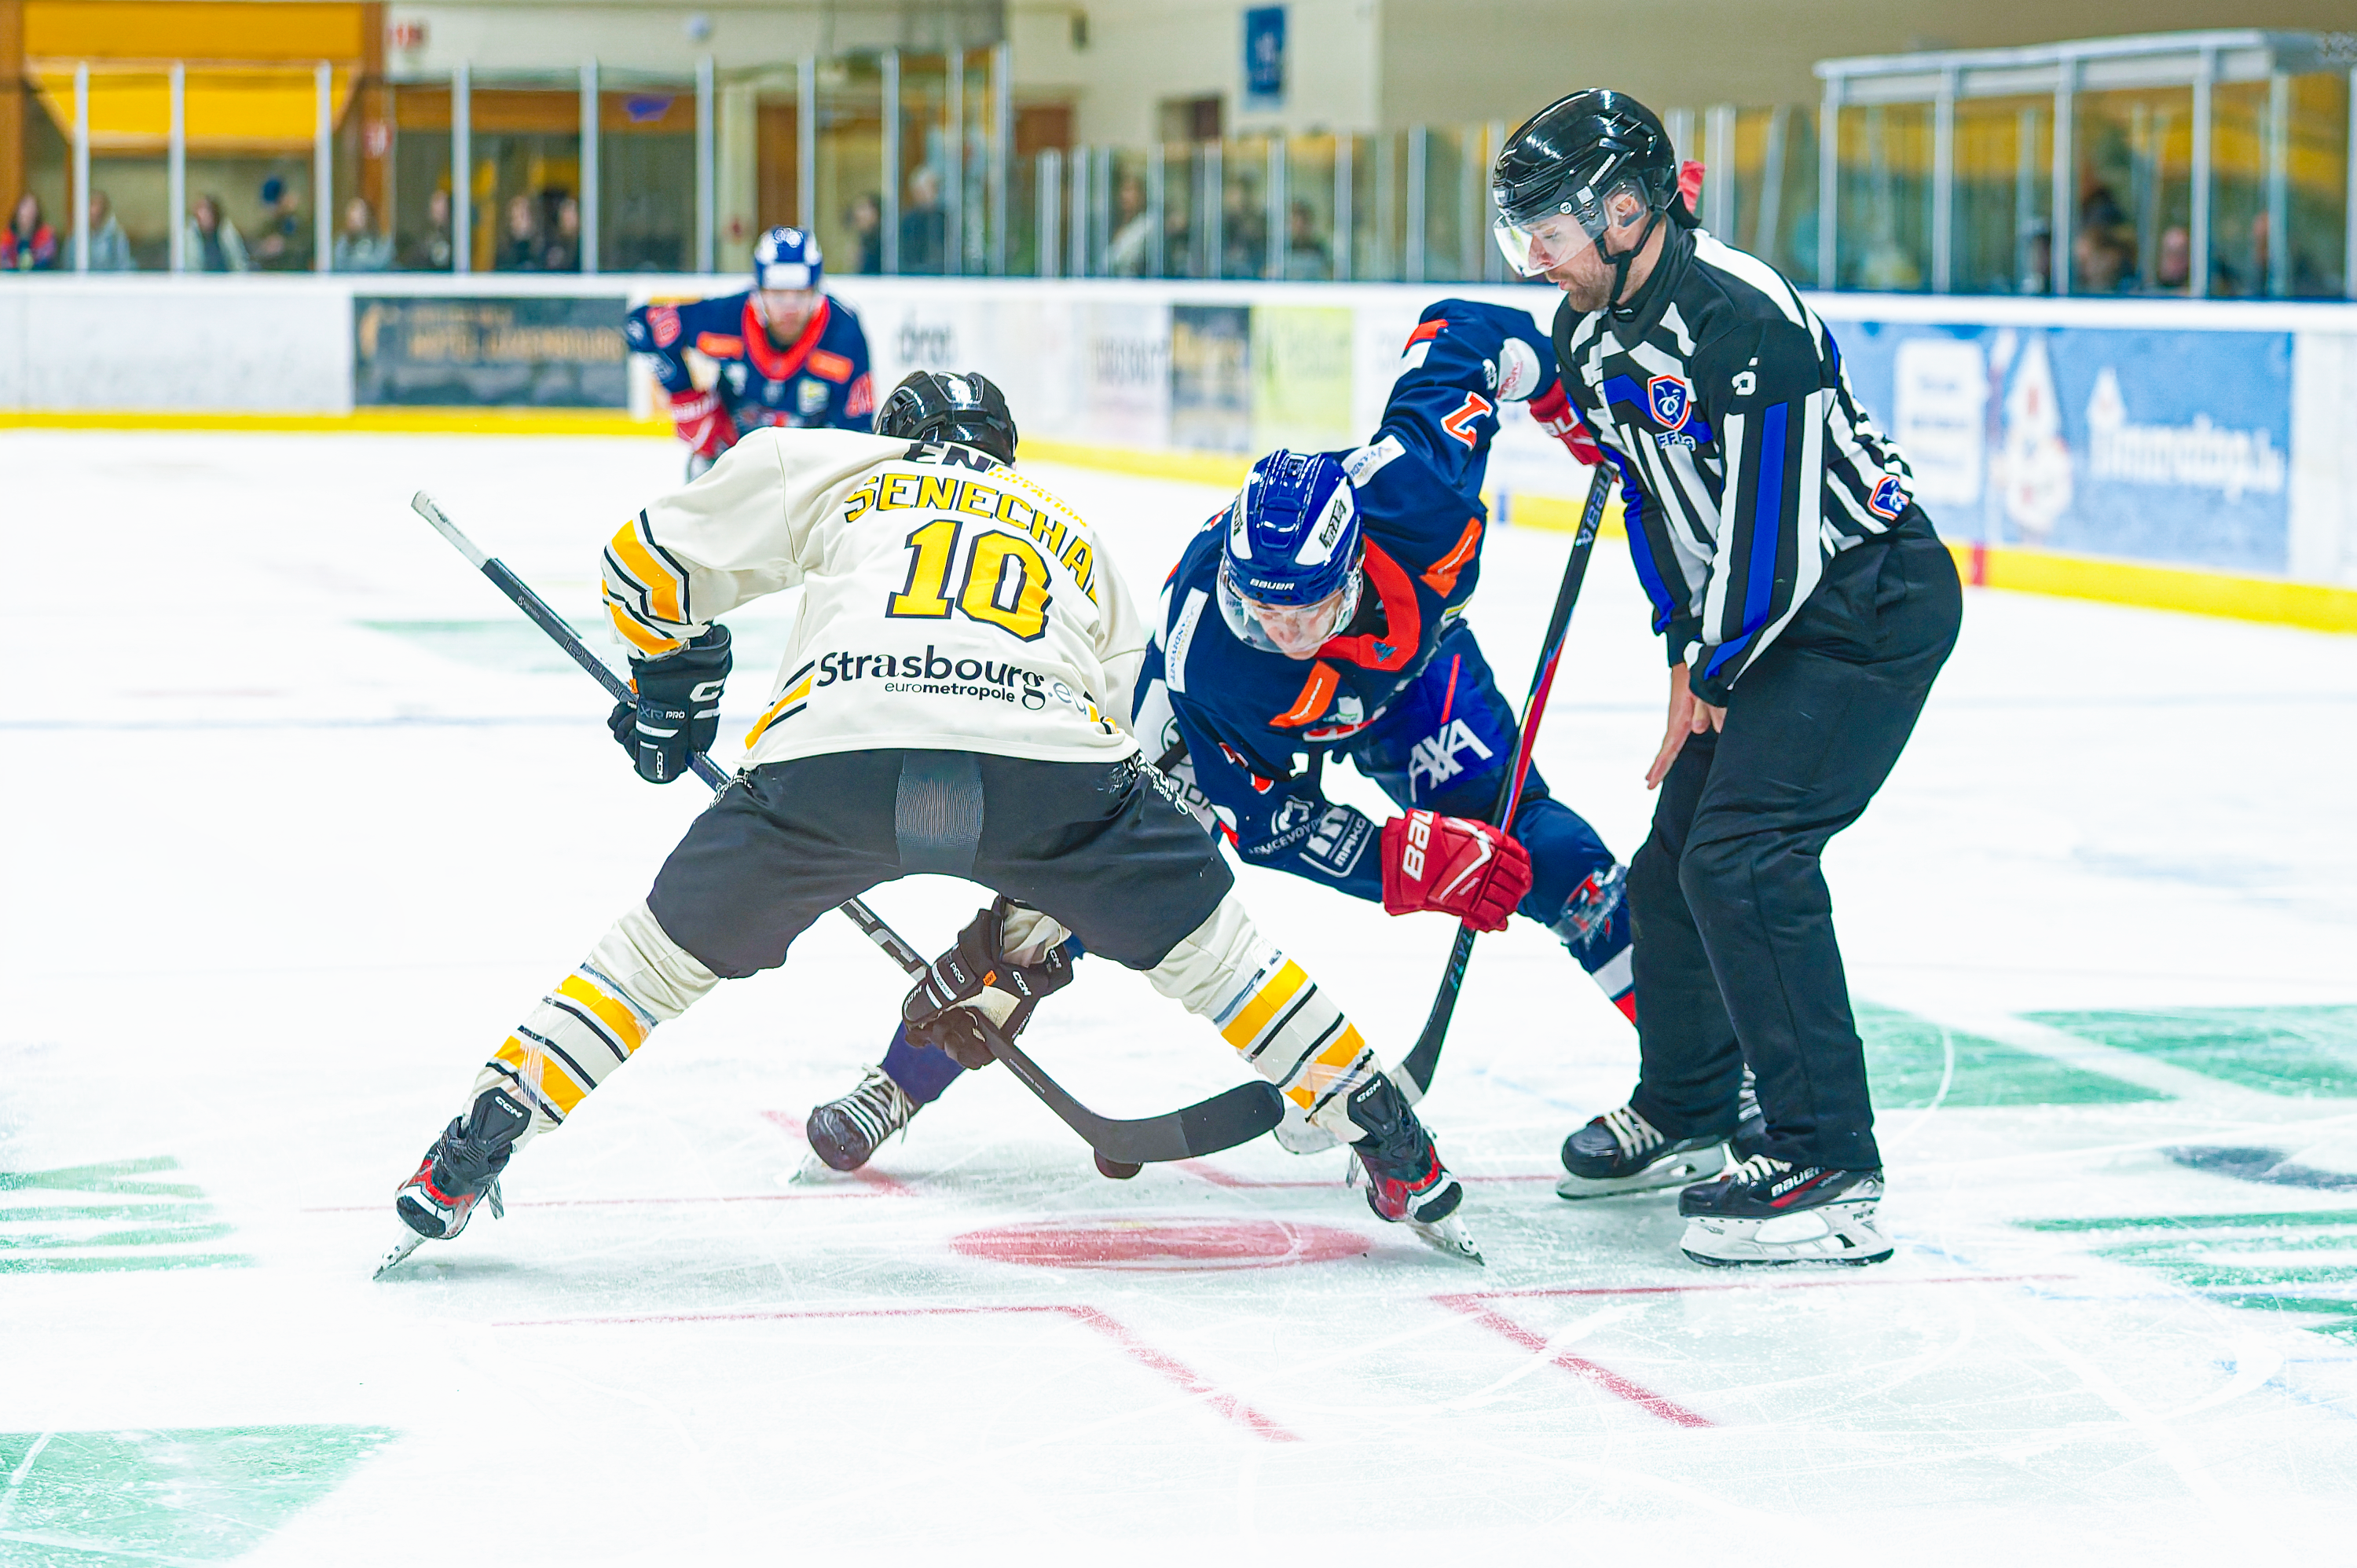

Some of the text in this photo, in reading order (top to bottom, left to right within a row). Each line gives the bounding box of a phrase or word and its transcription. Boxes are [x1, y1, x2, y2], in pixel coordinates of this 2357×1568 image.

[845, 473, 1099, 608] SENECHA
[885, 518, 1053, 643] 10
[1250, 578, 1295, 591] BAUER
[885, 681, 1016, 703] eurometropole
[1409, 717, 1494, 803] AXA
[949, 962, 966, 984] PRO
[1013, 971, 1032, 997] CCM
[495, 1095, 523, 1119] CCM
